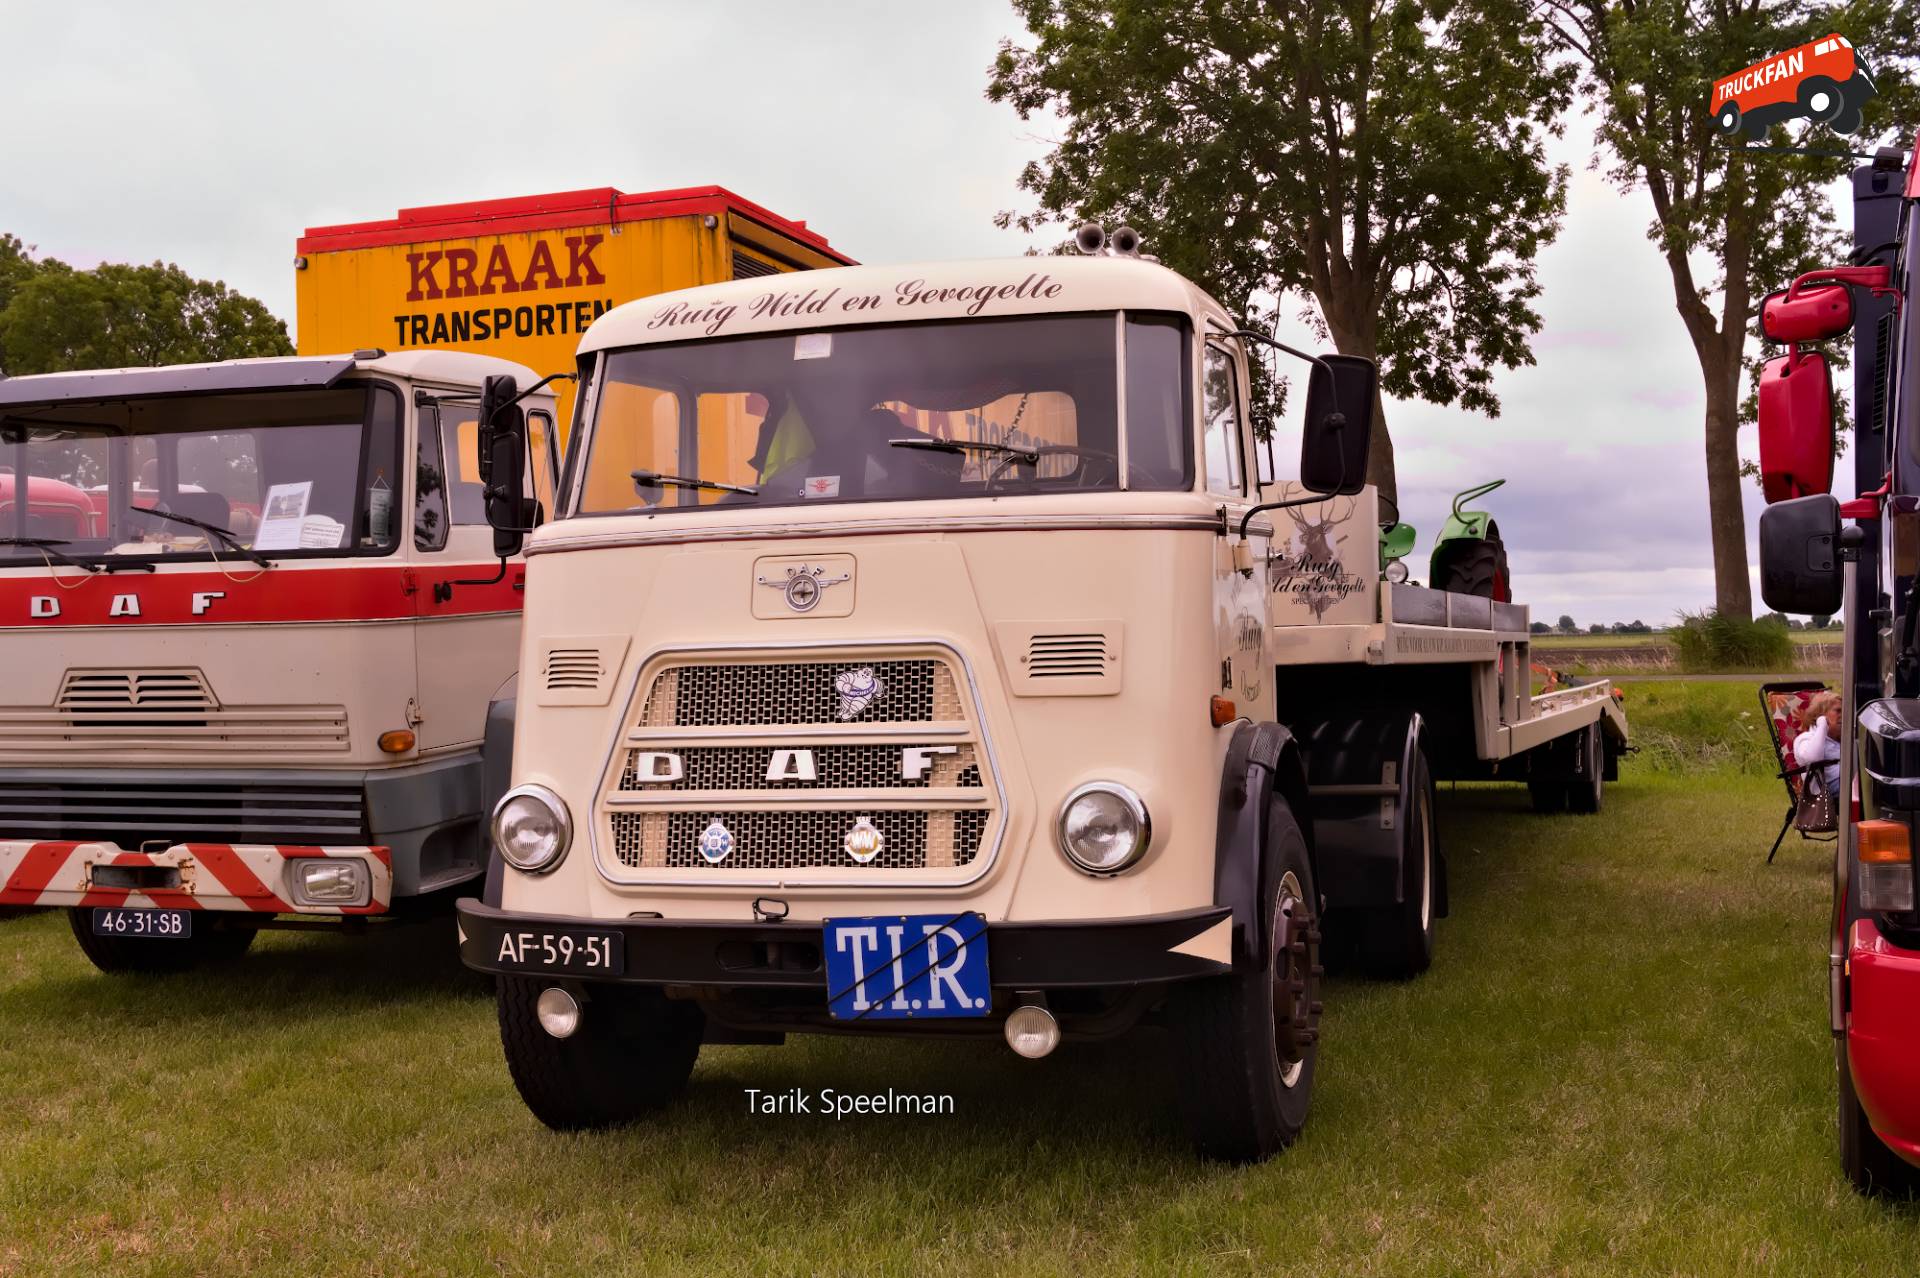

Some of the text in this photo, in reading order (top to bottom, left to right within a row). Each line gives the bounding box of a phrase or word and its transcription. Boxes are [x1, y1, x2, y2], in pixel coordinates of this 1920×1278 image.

[406, 234, 606, 302] KRAAK
[394, 299, 612, 346] TRANSPORTEN
[647, 273, 1063, 335] Ruig Wild en Gevogelte
[786, 563, 825, 579] DAF
[1291, 552, 1339, 582] Ruig
[498, 932, 610, 967] AF-59-51
[836, 925, 985, 1010] T.I.R.
